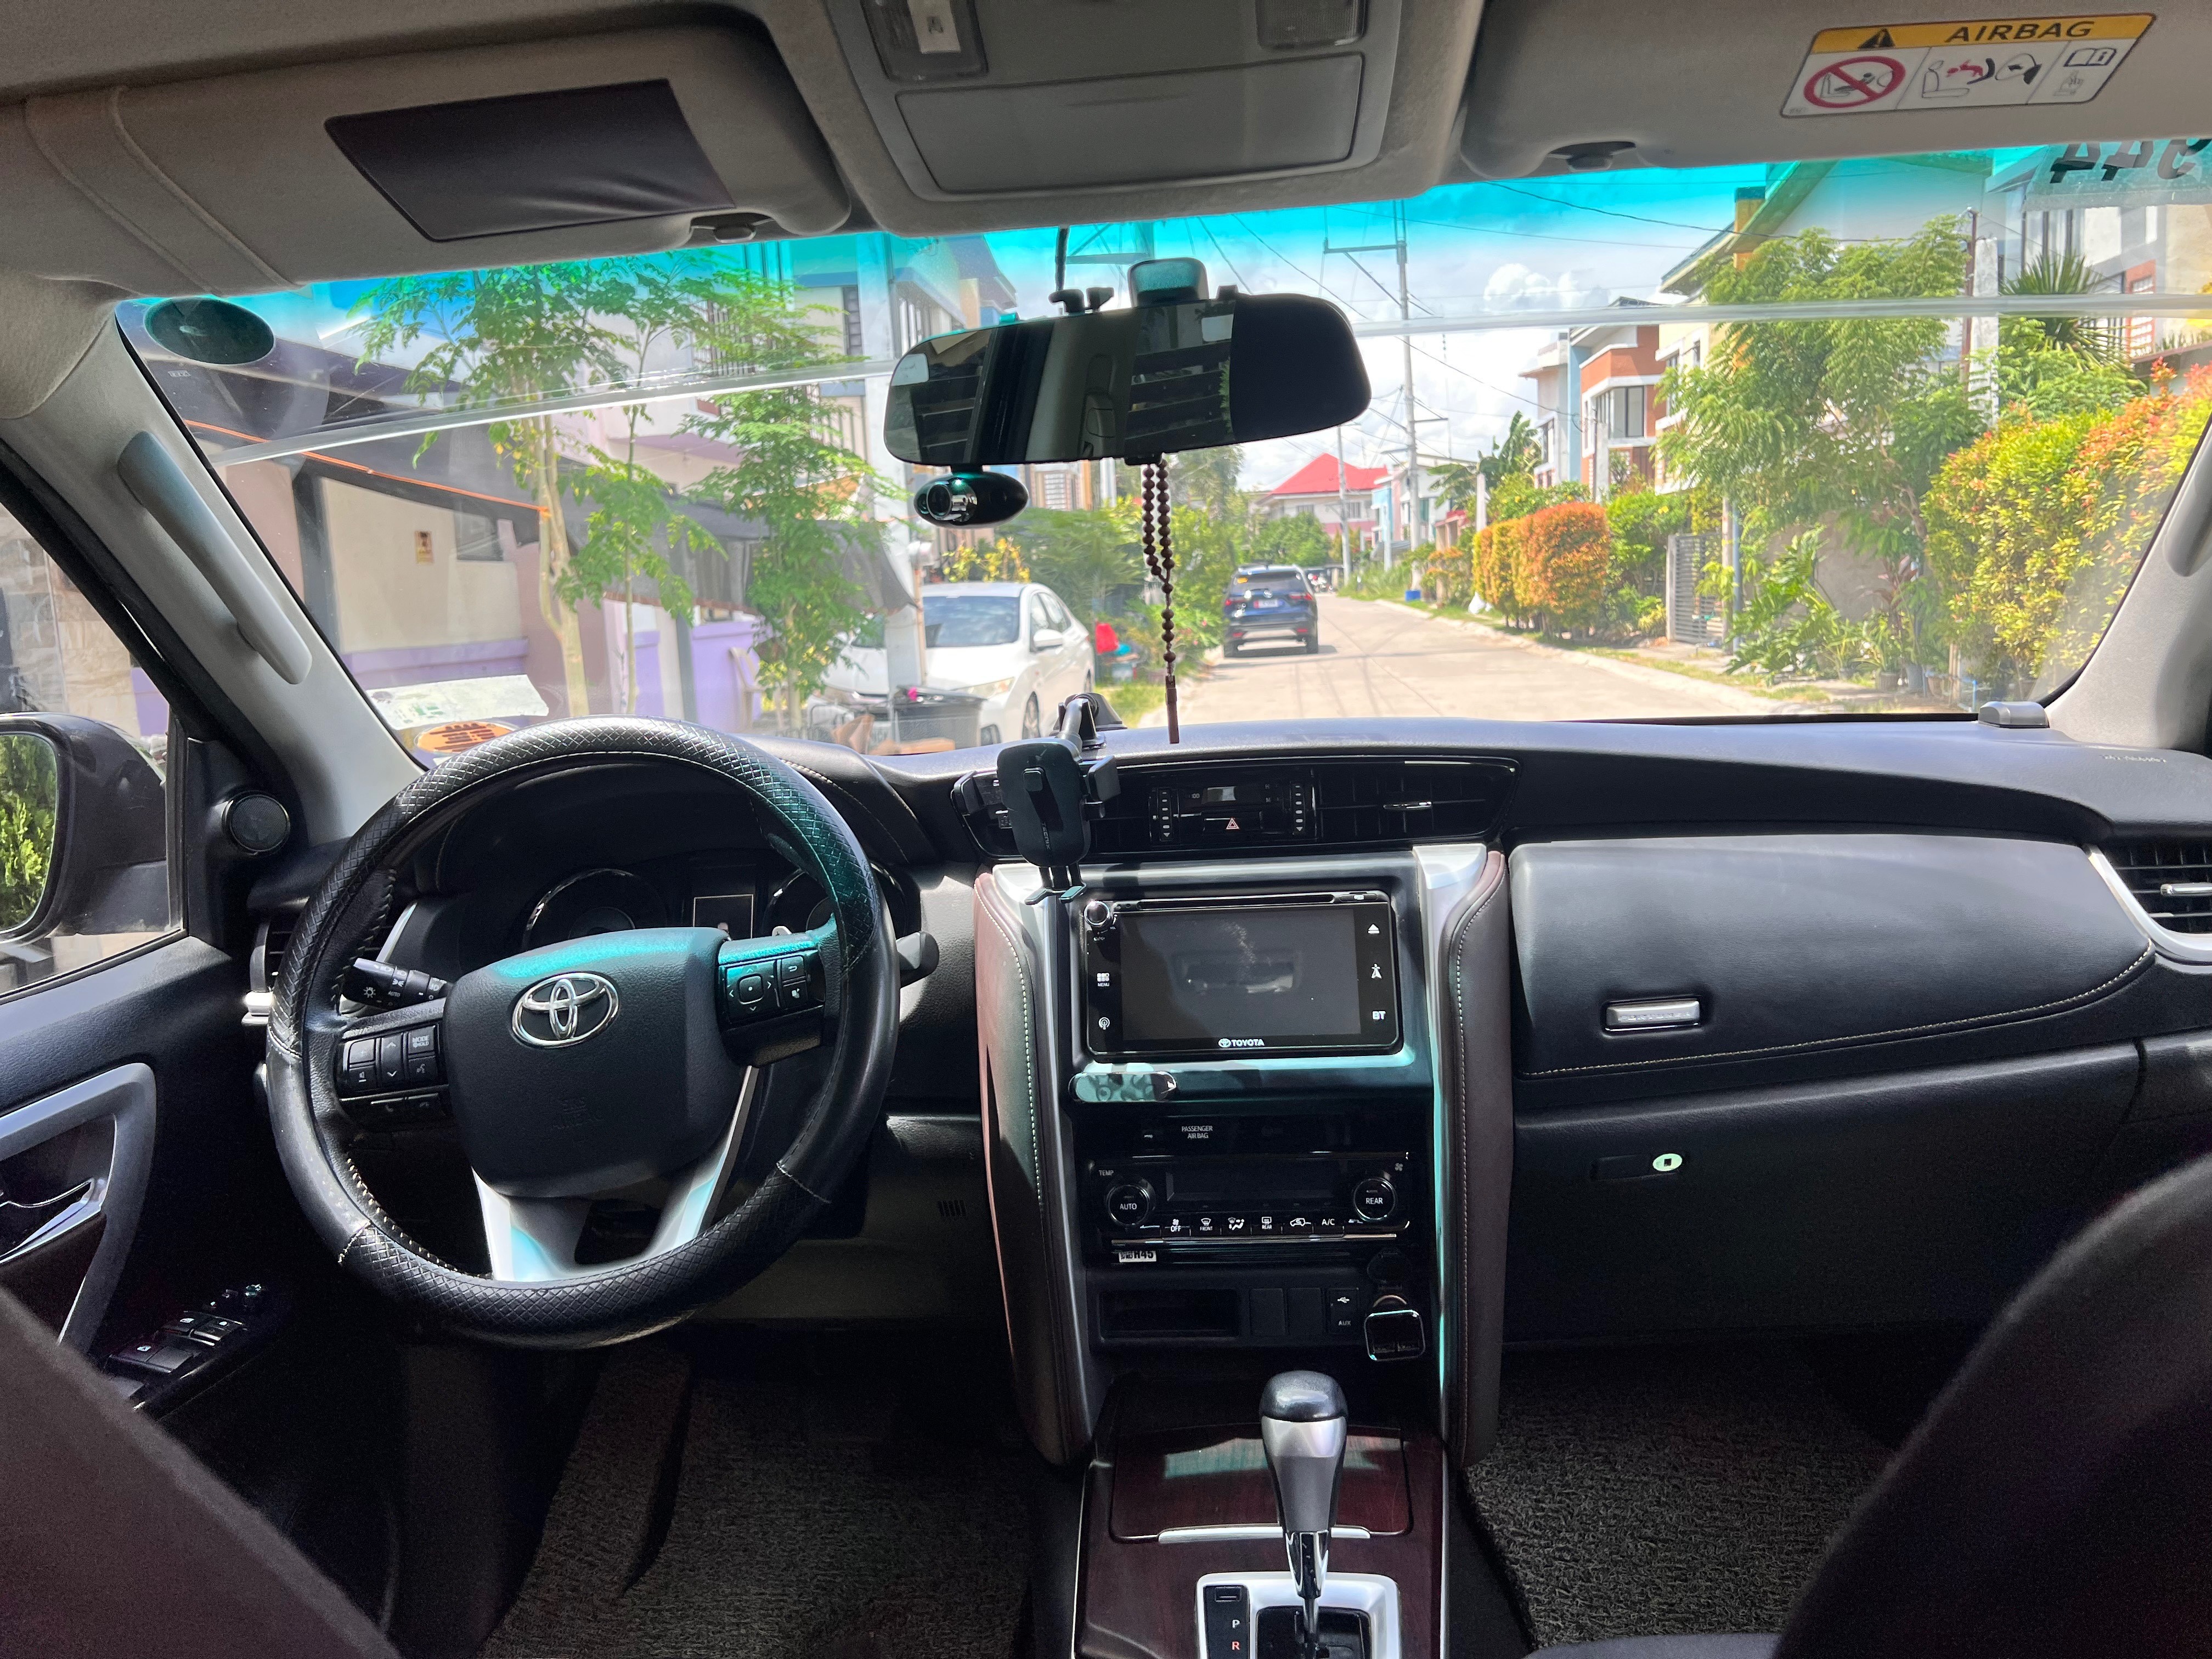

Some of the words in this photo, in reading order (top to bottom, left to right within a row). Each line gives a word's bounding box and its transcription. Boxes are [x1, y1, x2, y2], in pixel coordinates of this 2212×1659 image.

[1944, 20, 2095, 43] AIRBAG
[1372, 1011, 1386, 1020] BT
[1231, 1039, 1265, 1047] TOYOTA
[1232, 1619, 1240, 1628] P
[1232, 1641, 1240, 1650] R
